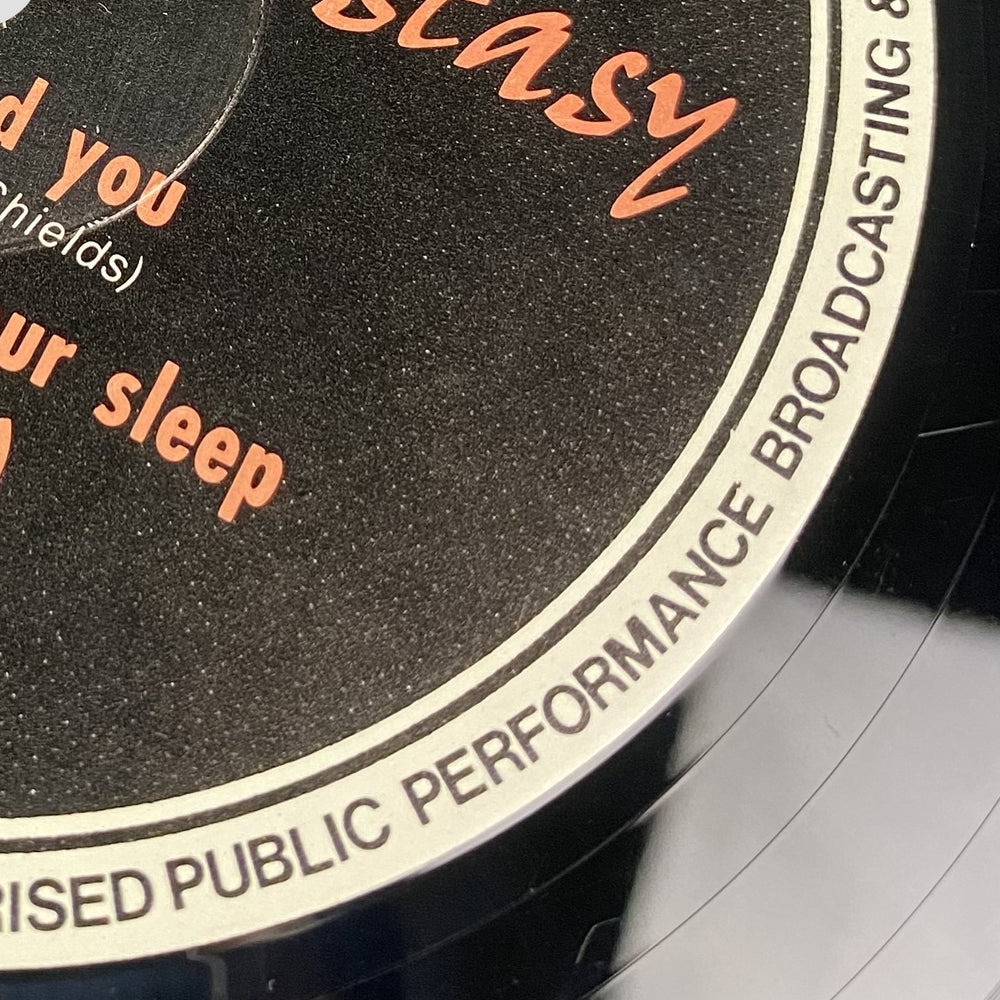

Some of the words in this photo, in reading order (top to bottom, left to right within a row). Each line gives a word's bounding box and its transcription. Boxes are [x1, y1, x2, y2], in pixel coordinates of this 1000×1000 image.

[46, 129, 187, 227] you
[92, 361, 285, 523] sleep
[165, 797, 391, 911] PUBLIC
[402, 482, 774, 825] PERFORMANCE
[751, 38, 911, 480] BROADCASTING
